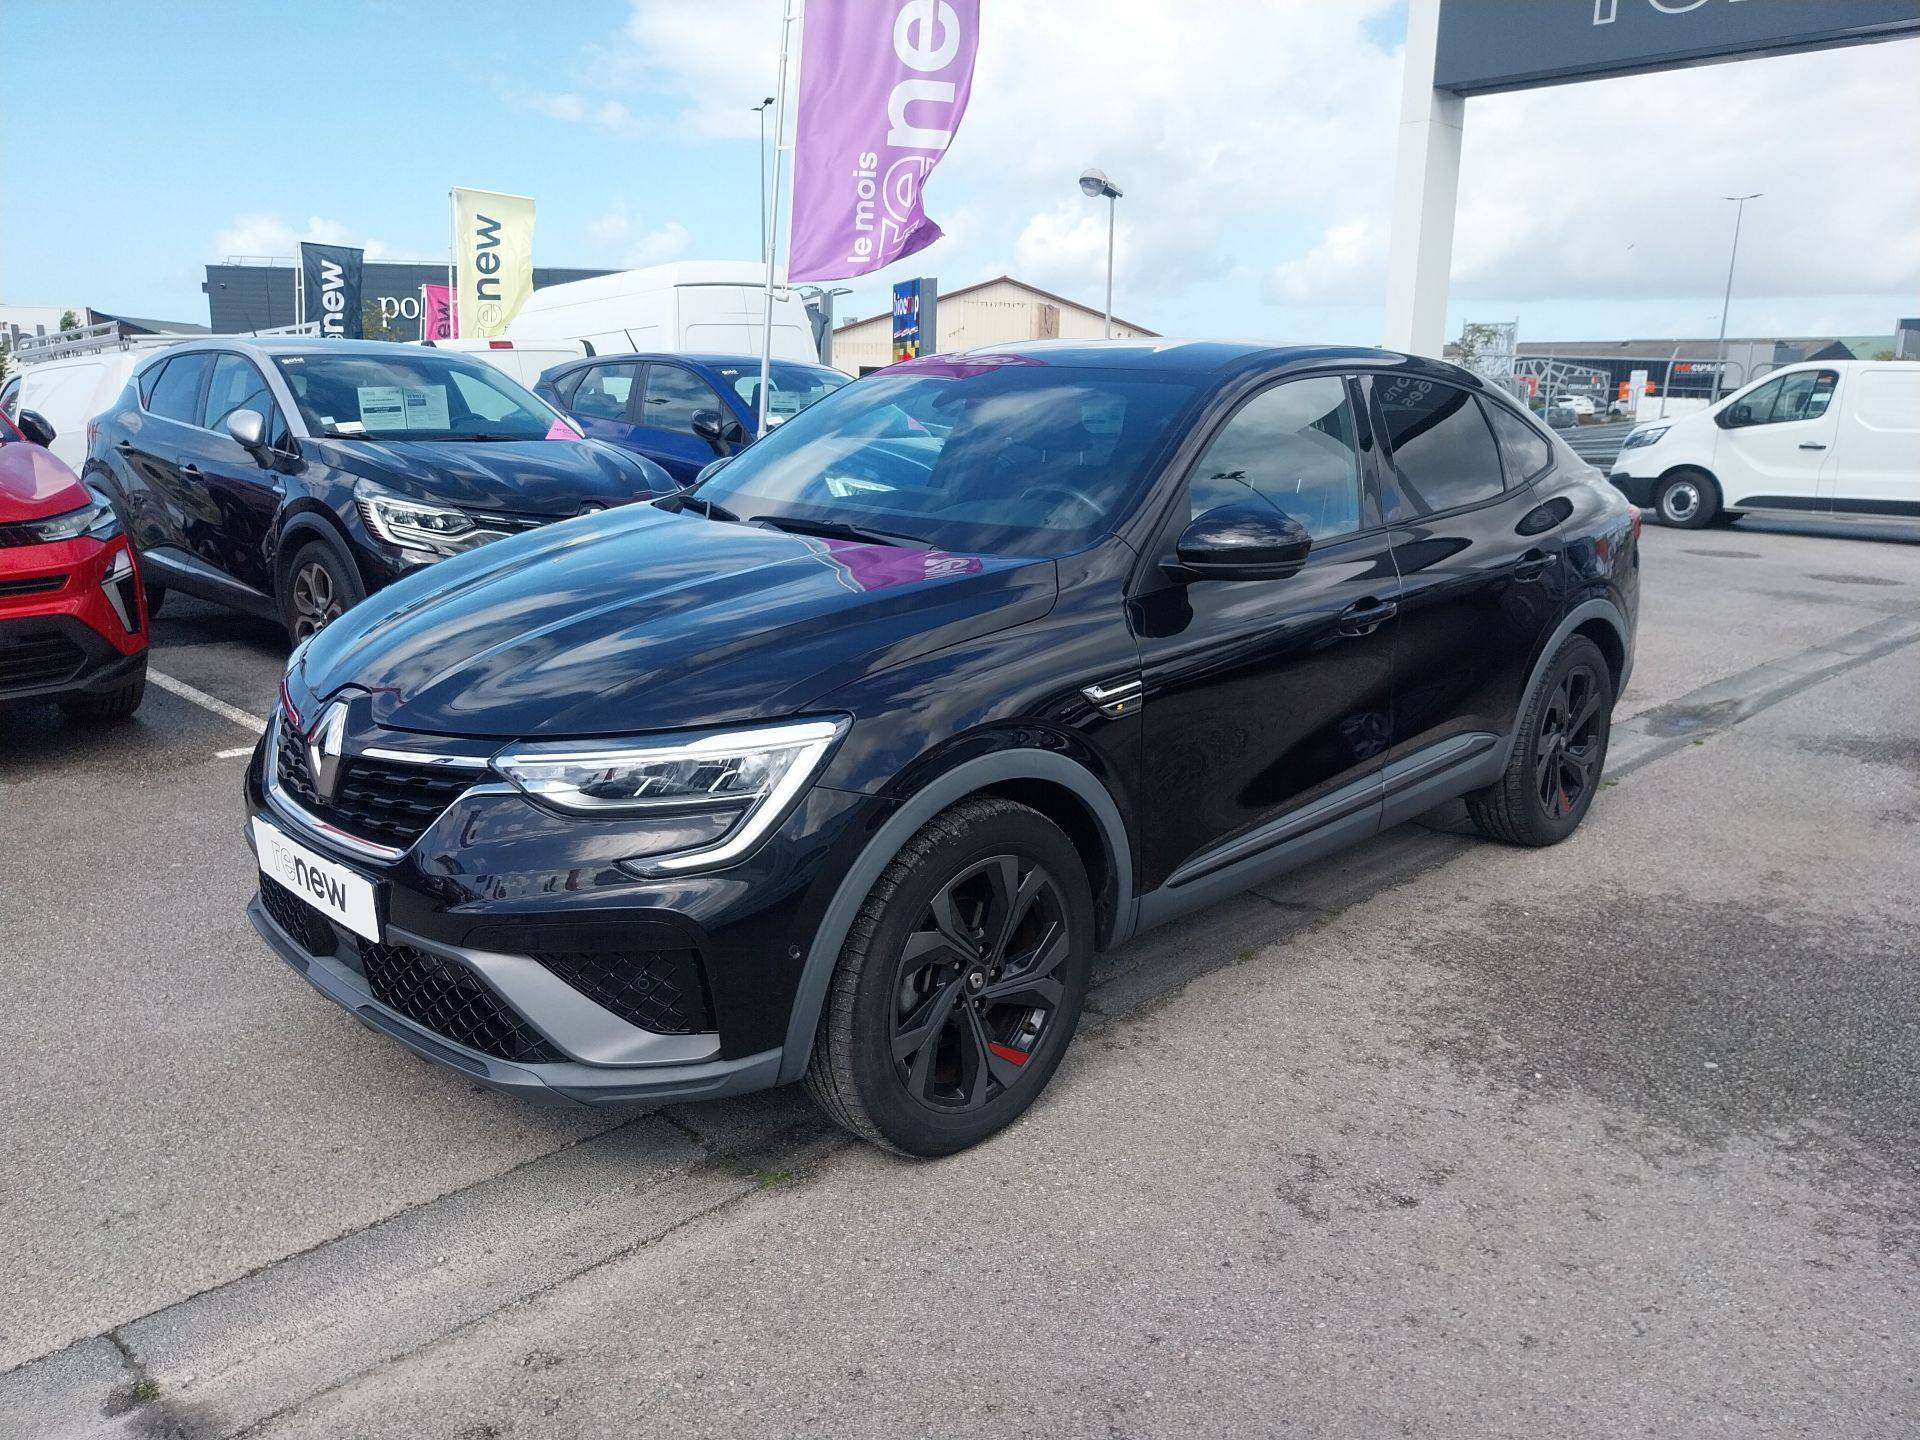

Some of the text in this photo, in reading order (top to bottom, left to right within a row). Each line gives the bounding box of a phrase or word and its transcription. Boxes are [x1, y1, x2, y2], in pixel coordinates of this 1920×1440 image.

[847, 152, 878, 263] le mois
[271, 840, 346, 912] renew
